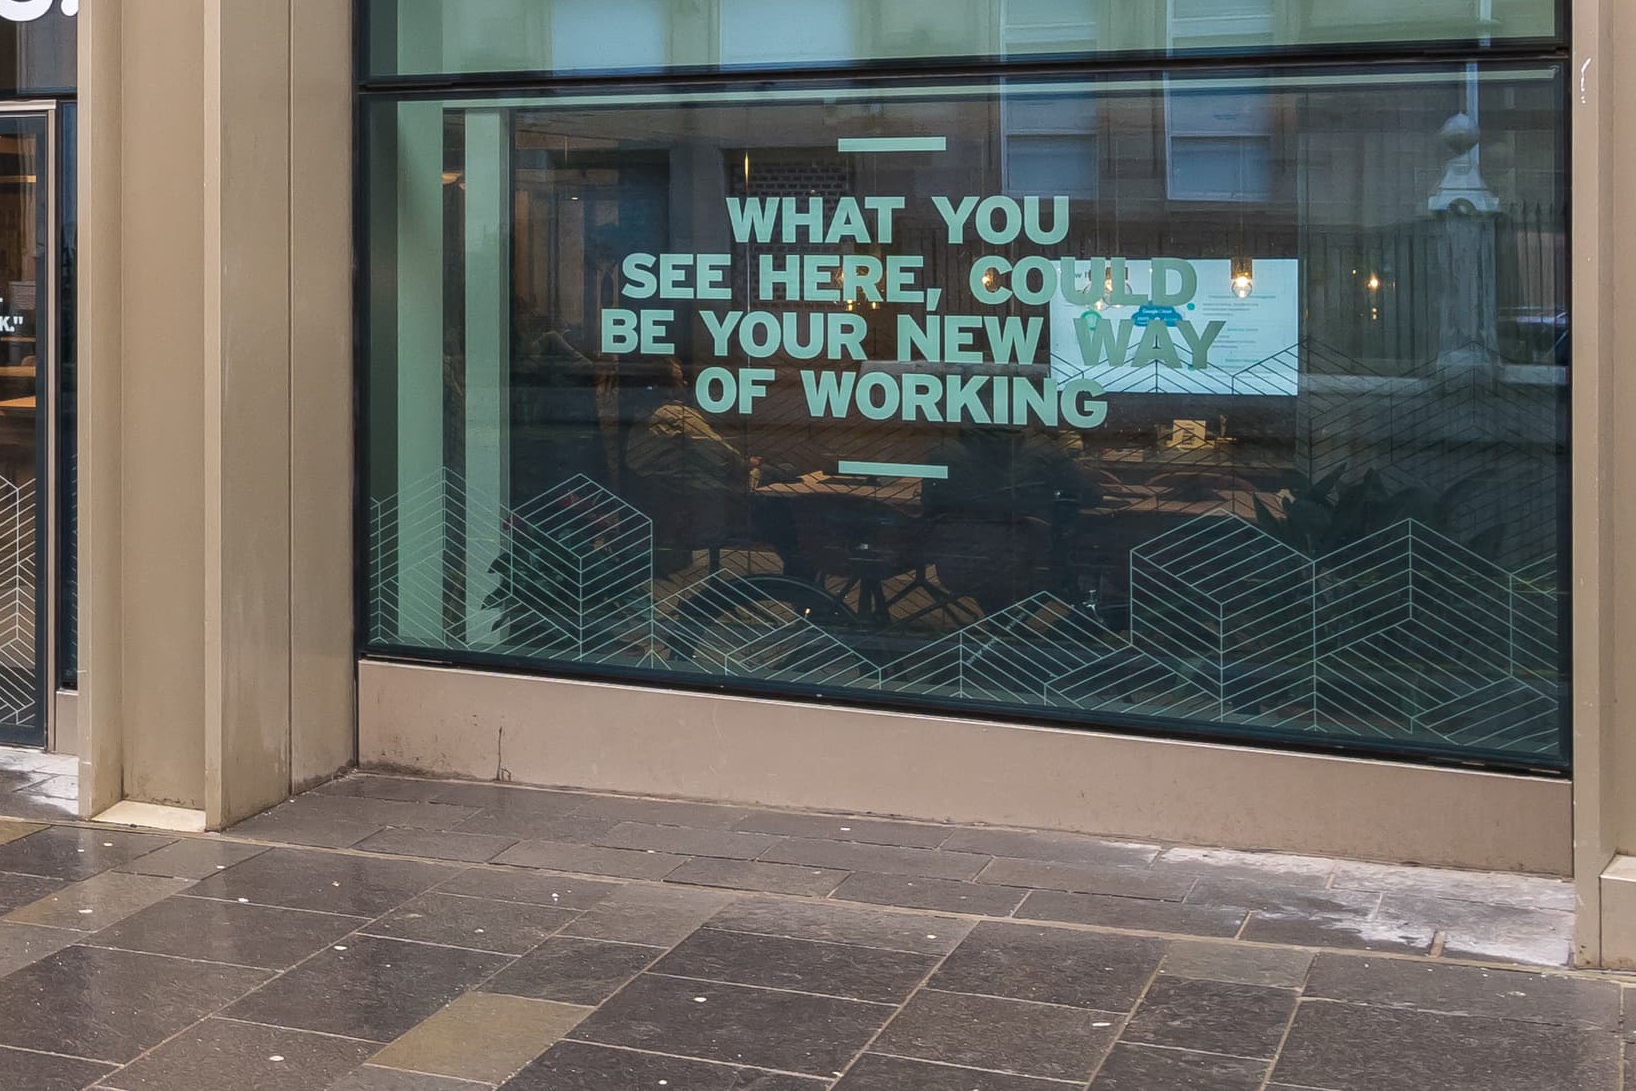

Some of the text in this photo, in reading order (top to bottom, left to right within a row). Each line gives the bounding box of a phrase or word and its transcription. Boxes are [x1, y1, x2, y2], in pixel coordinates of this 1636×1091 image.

[726, 195, 1069, 246] WHAT YOU
[621, 253, 1198, 311] SEE HERE, COULD
[601, 309, 1226, 370] BE YOUR NEW WAY
[694, 367, 1109, 429] OF WORKING
